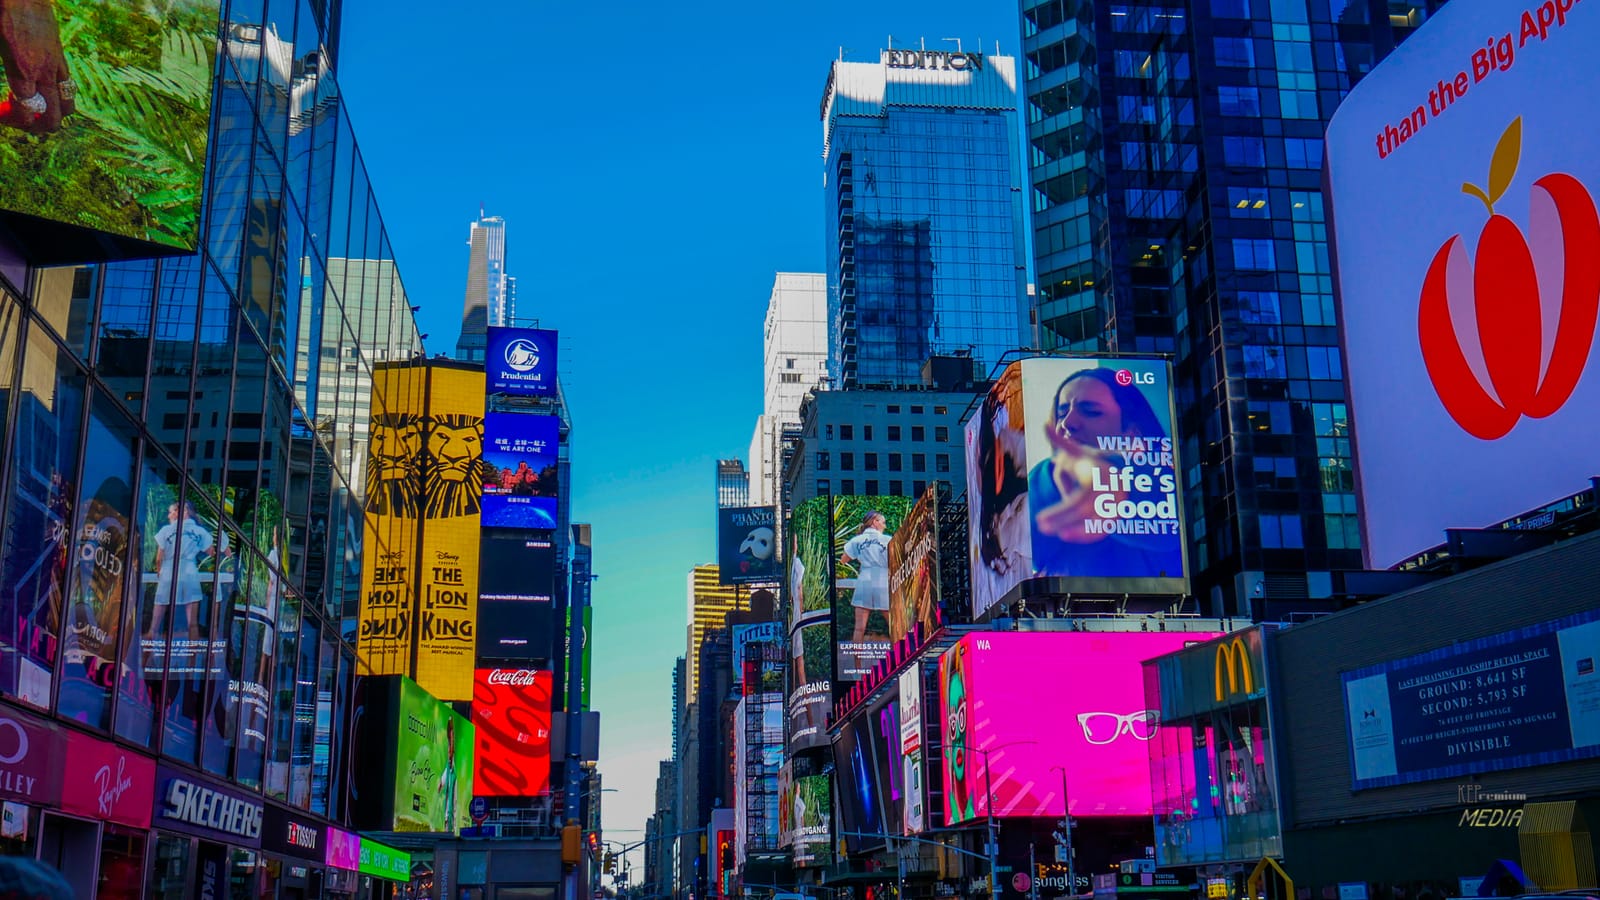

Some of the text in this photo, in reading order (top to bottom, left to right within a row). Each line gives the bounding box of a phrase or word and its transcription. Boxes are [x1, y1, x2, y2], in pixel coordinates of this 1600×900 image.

[886, 49, 983, 72] EDITION
[1376, 0, 1583, 160] than the Big App
[501, 371, 541, 382] Prudential
[1135, 372, 1155, 385] LG
[1096, 436, 1172, 452] WHAT'S
[1120, 452, 1173, 467] YOUR
[1091, 467, 1175, 493] Life's
[1094, 494, 1177, 519] Good
[1084, 519, 1179, 535] MOMENT?
[432, 567, 462, 583] THE
[427, 584, 468, 609] LION
[421, 611, 473, 641] KING
[739, 624, 771, 644] LITTLE
[977, 639, 991, 650] WA
[1524, 647, 1550, 662] SPACE
[487, 668, 538, 686] Coca-Cola
[1419, 679, 1472, 700] GROUND:
[1512, 666, 1527, 681] SF
[1422, 696, 1473, 716] SECOND:
[1512, 684, 1527, 699] SF
[1448, 735, 1512, 757] DIVISIBLE
[162, 777, 264, 839] SKECHERS
[297, 824, 318, 849] TISSOT
[1034, 873, 1089, 891] sunglss
